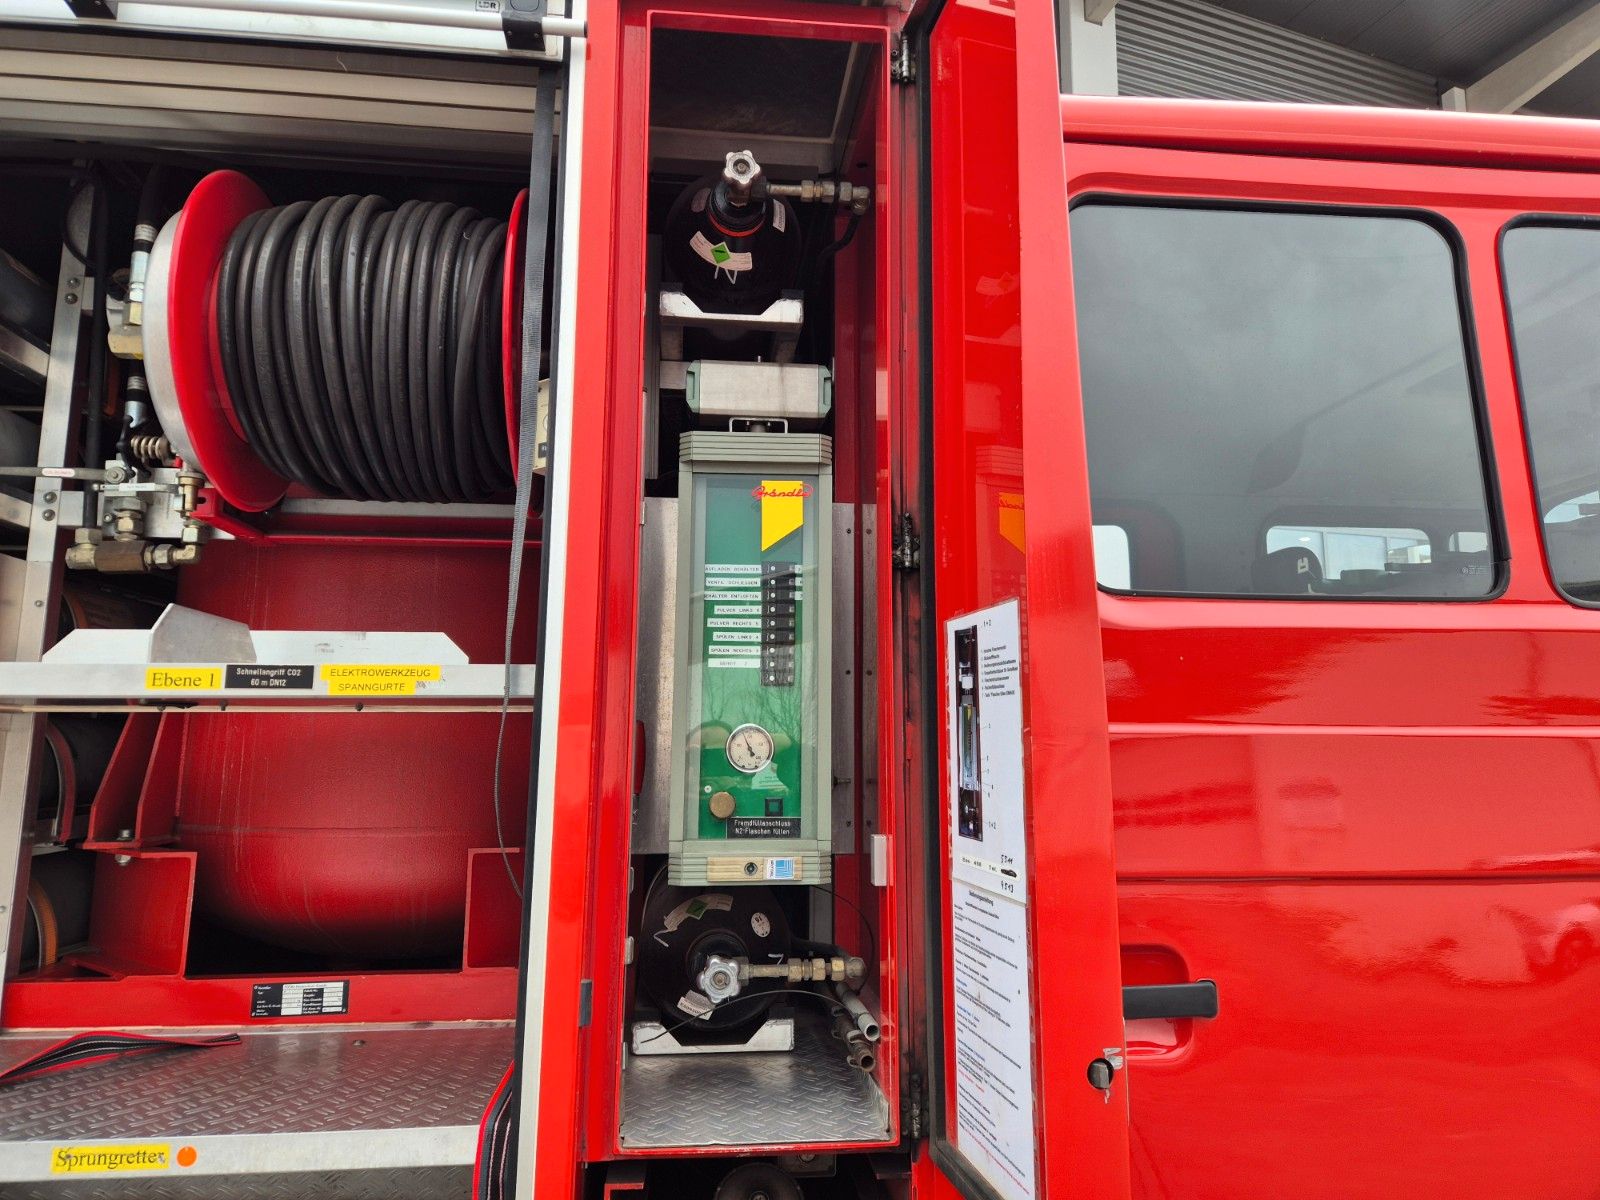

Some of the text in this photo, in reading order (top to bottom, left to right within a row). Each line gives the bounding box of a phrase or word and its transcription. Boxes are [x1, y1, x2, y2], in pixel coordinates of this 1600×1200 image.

[236, 667, 301, 677] Schnellangriff CO2
[330, 668, 431, 677] ELEKTROWERKZEUG
[152, 672, 202, 687] Ebene
[269, 679, 286, 687] DN12
[338, 682, 405, 691] SPANNGURTE
[56, 1147, 165, 1171] Sprungretter
